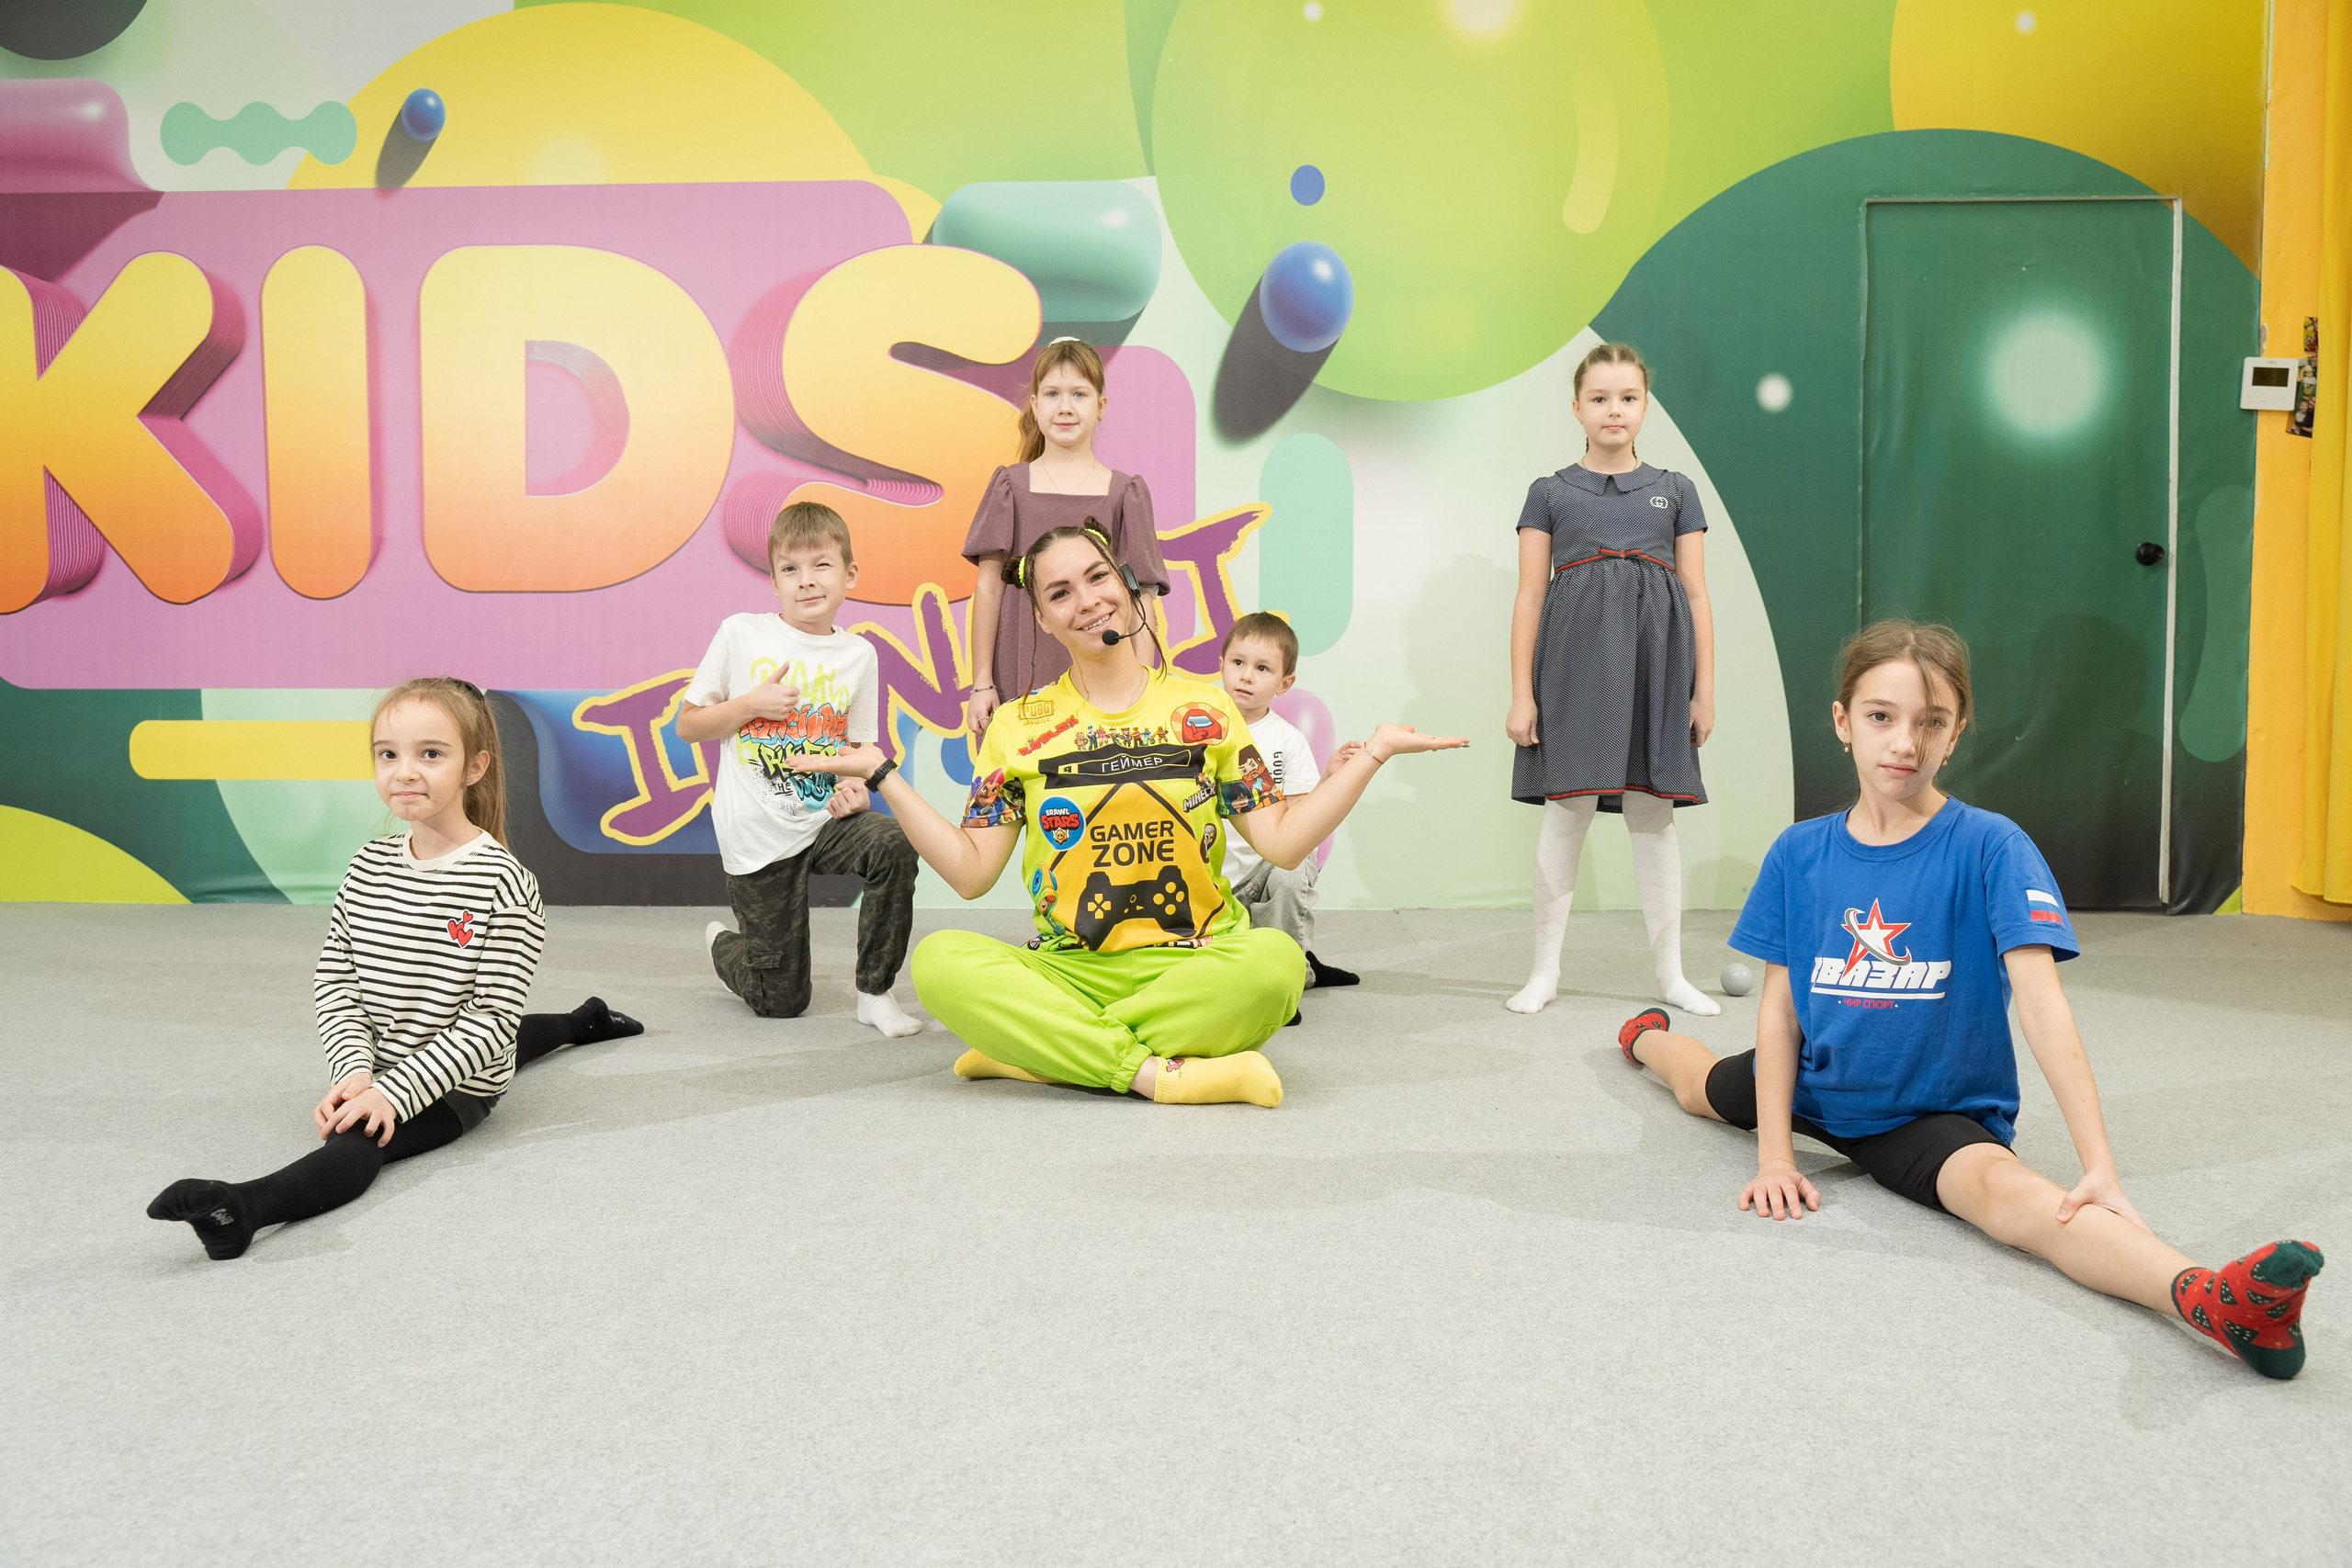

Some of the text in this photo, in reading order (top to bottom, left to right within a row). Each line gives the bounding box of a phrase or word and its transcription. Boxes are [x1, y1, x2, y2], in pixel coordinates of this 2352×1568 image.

[0, 243, 1043, 614] KIDS
[1017, 714, 1080, 756] ROBLOX
[1102, 754, 1163, 773] ГЕЙМЕР
[1272, 750, 1283, 784] GOOD
[1040, 813, 1081, 831] STARS
[1046, 807, 1070, 817] BRAWL
[1090, 820, 1175, 843] GAMER
[1091, 839, 1175, 868] ZONE
[1842, 997, 1894, 1010] ЧИР СПОРТ
